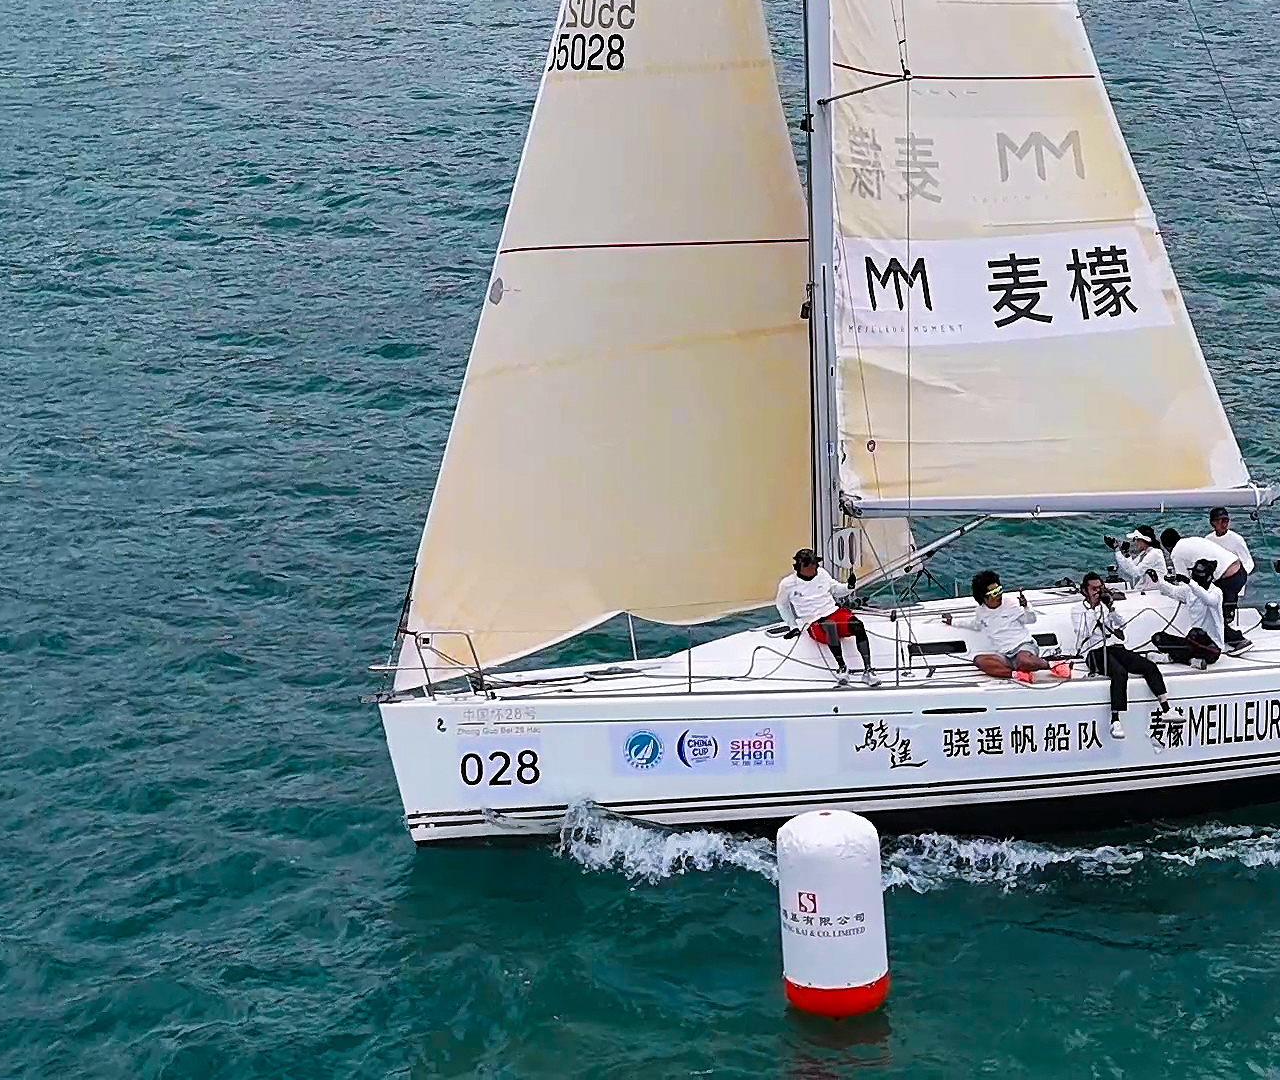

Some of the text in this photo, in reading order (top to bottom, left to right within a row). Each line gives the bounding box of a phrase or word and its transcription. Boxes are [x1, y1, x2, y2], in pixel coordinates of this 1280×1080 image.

[548, 33, 625, 72] 5028
[986, 245, 1139, 328] 麦檬
[687, 739, 713, 749] CHINA
[692, 748, 709, 757] CUP
[942, 720, 1103, 758] 骁遥帆船队
[460, 749, 540, 786] 028
[833, 925, 866, 937] LIMITED
